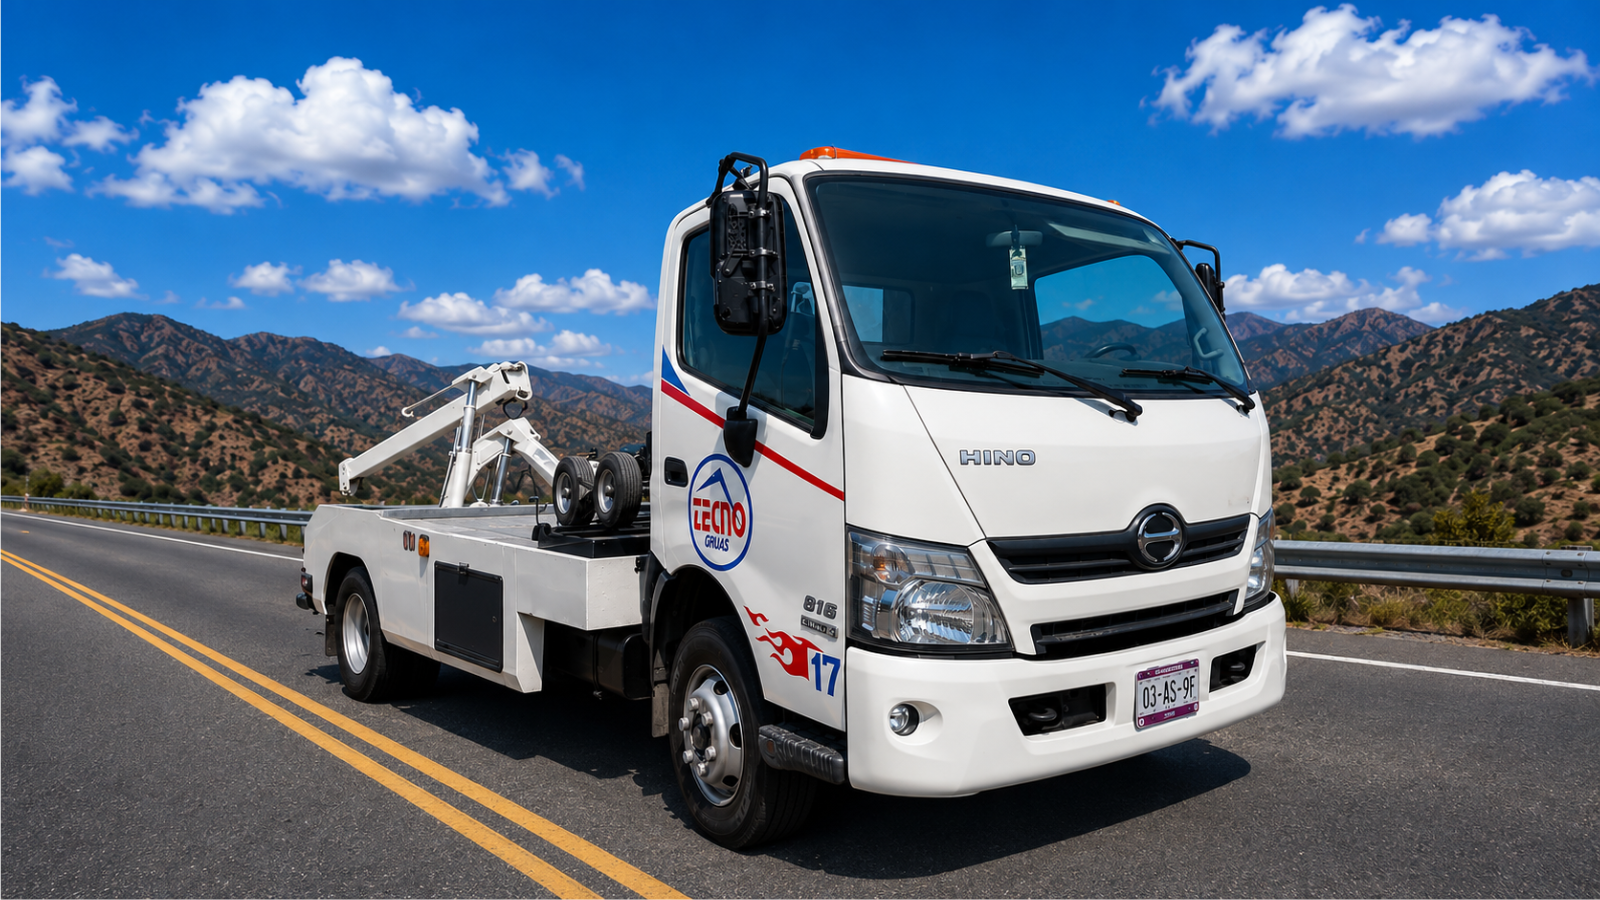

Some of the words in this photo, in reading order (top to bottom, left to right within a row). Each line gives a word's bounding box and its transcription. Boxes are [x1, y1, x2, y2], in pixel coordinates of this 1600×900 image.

[959, 449, 1036, 466] HINO
[692, 497, 746, 538] TECNO
[704, 534, 730, 552] GRUAS
[811, 652, 841, 697] 17
[1142, 675, 1196, 709] 03-AS-9F
